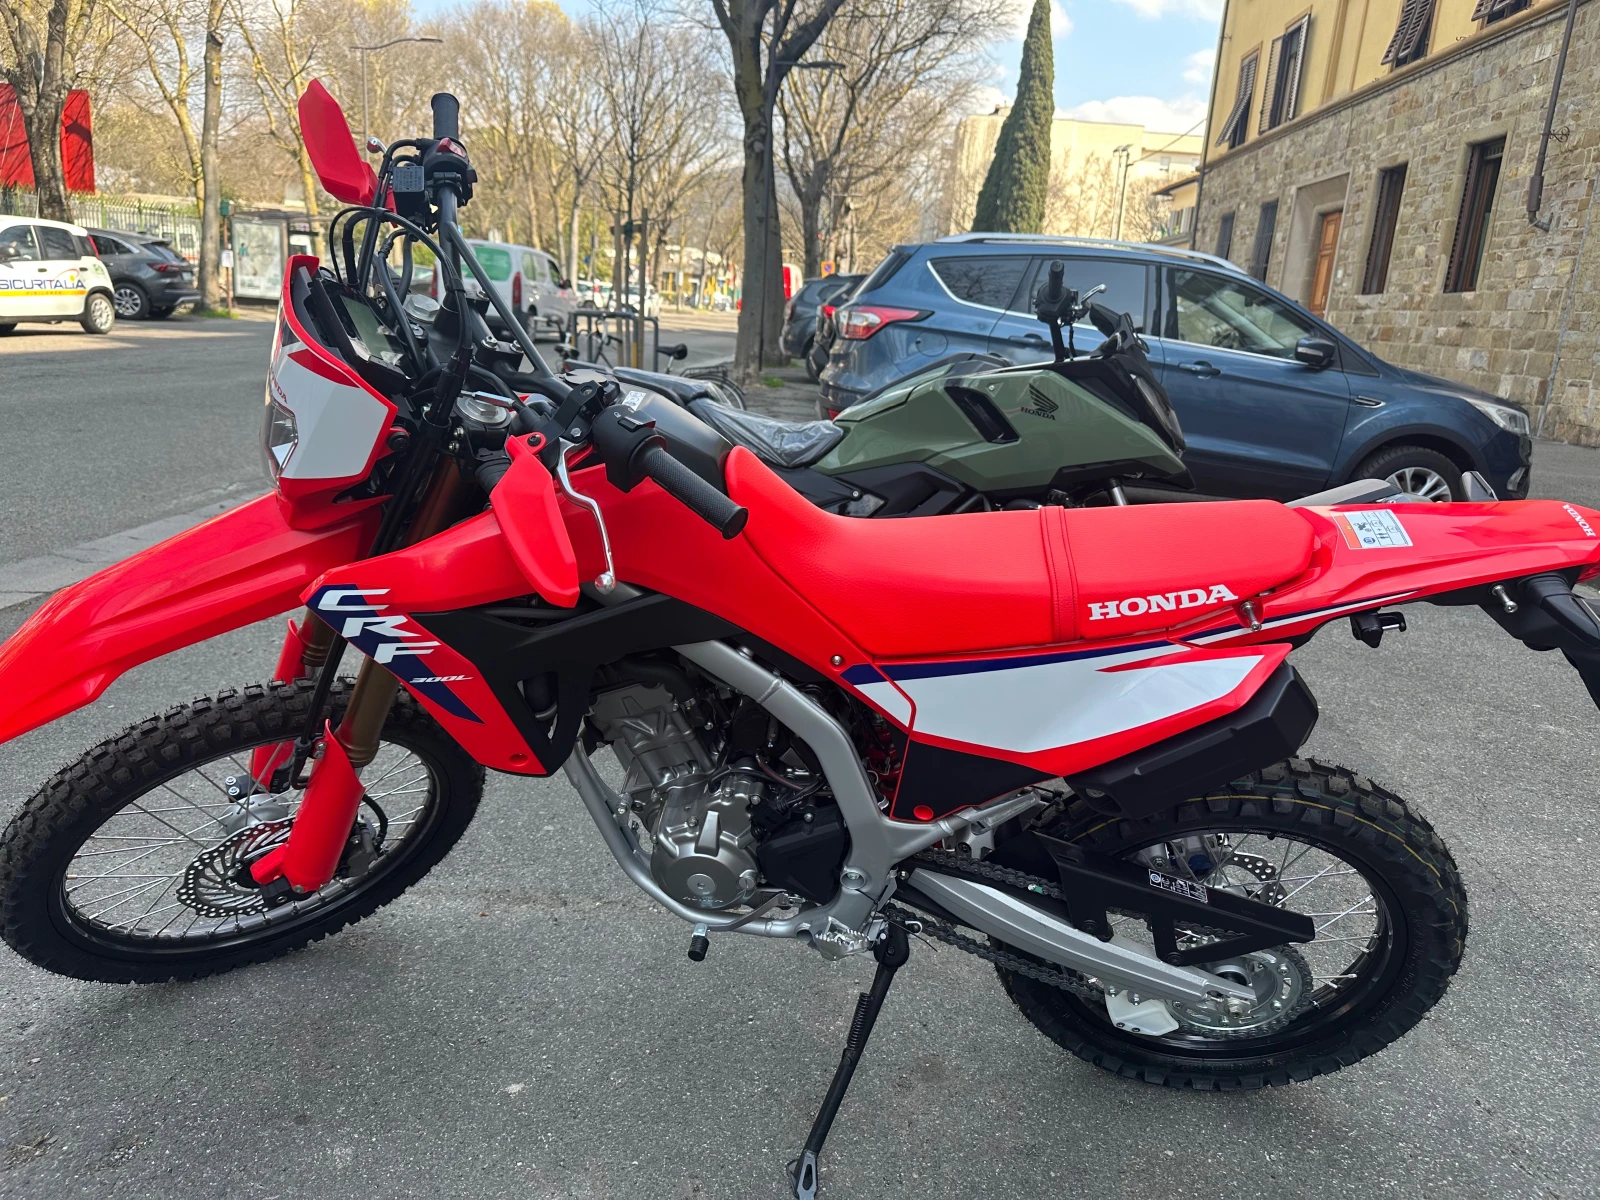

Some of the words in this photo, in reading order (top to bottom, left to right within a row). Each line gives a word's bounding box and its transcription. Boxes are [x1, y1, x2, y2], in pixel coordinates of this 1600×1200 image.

[0, 279, 86, 289] SICURITALIA
[1020, 407, 1056, 420] HONDA
[1562, 504, 1597, 537] HONDA
[1087, 584, 1239, 620] HONDA
[318, 588, 442, 664] CRF
[409, 674, 474, 683] 300L
